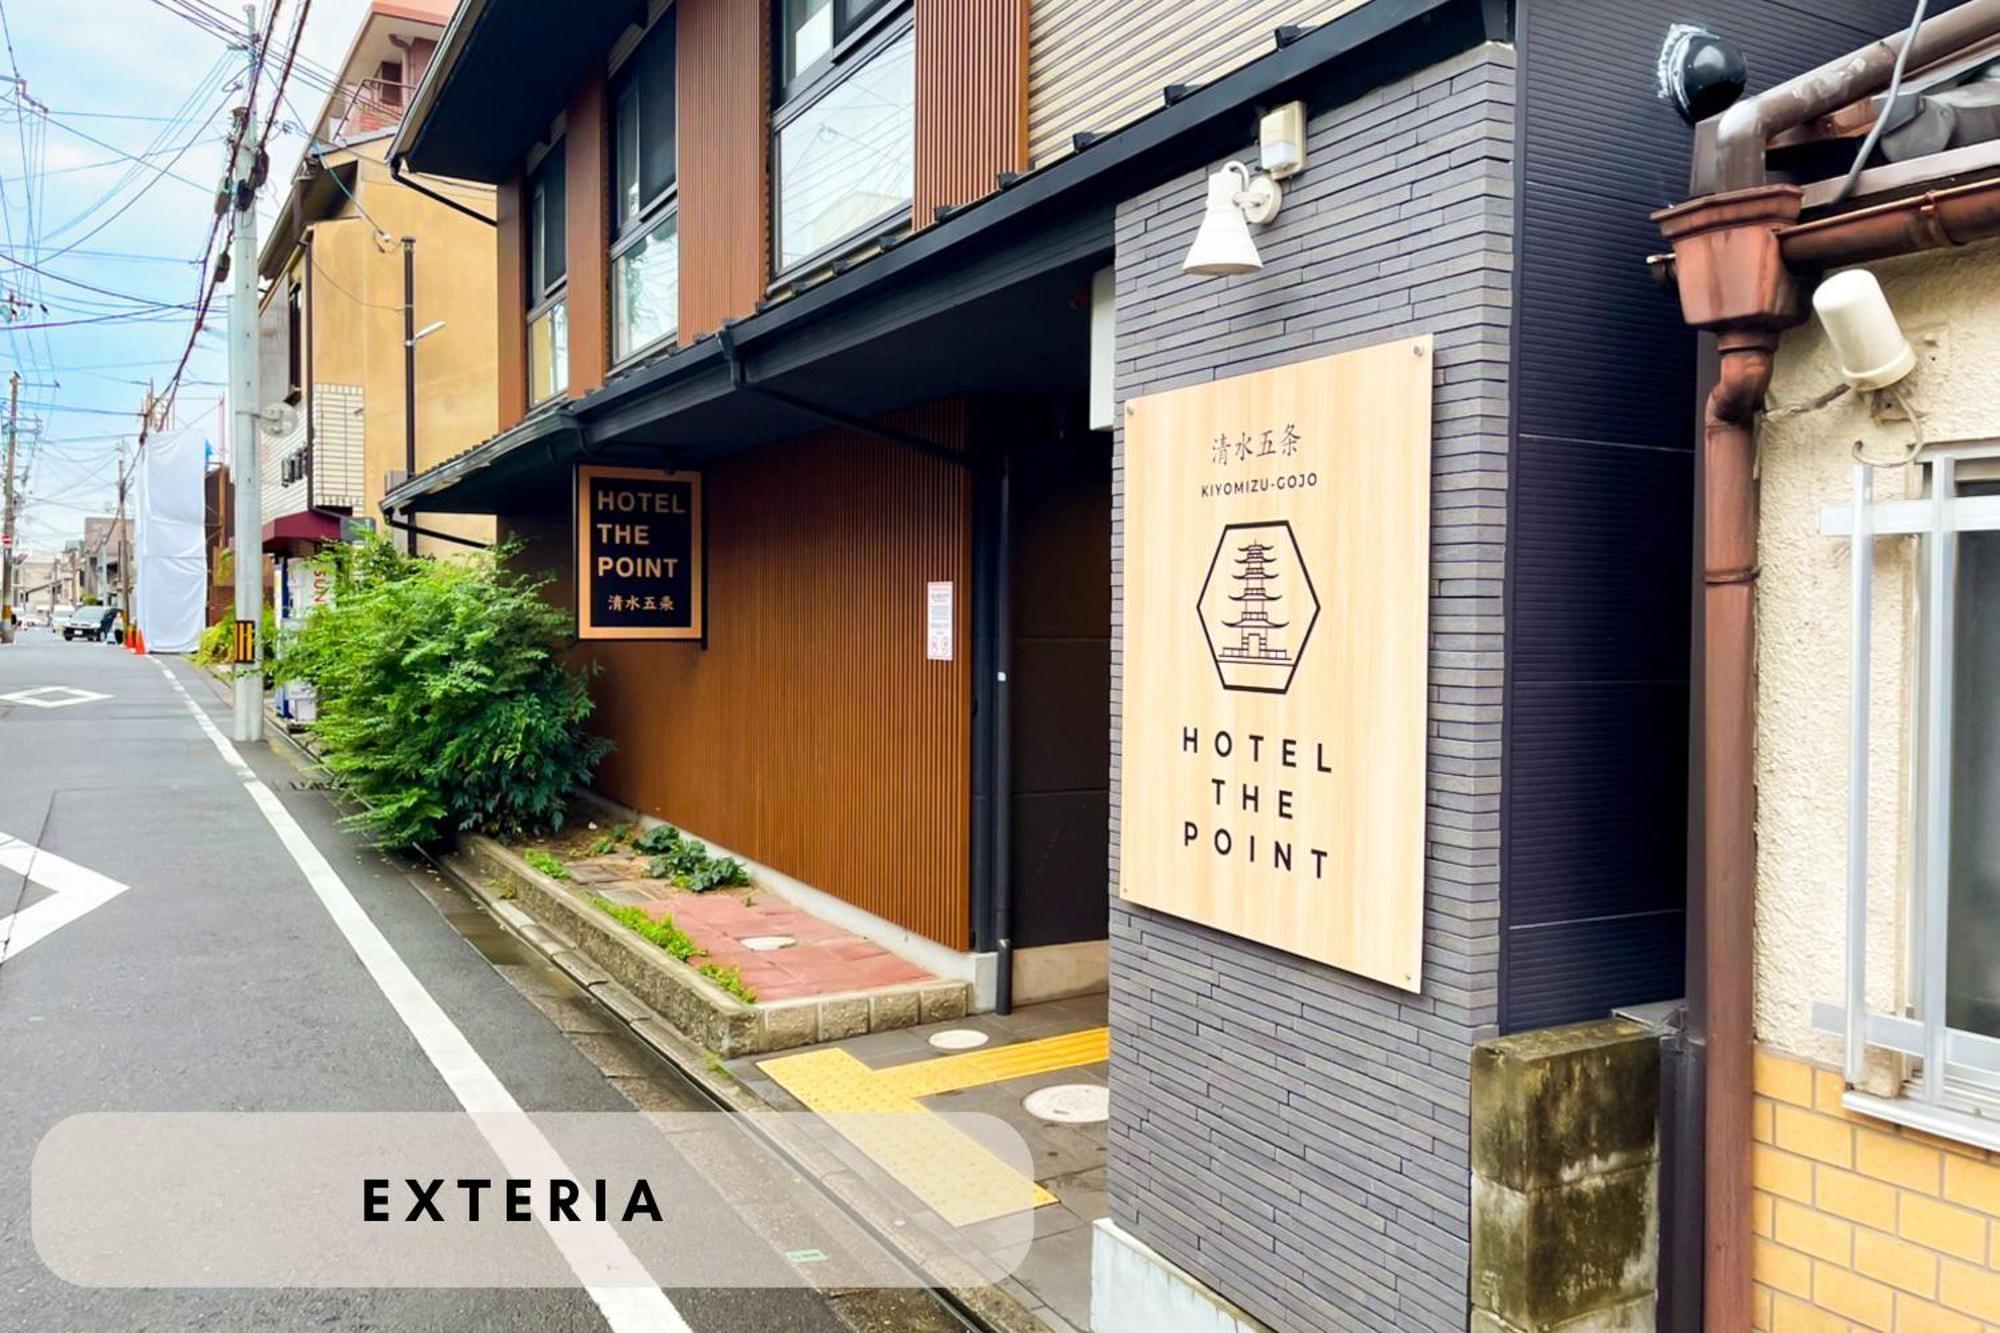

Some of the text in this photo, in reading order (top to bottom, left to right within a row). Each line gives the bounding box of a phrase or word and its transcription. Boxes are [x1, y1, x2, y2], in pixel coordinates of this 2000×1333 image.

[1212, 424, 1301, 465] 清水五条
[597, 490, 686, 514] HOTEL
[597, 523, 650, 545] THE
[598, 556, 678, 579] POINT
[608, 594, 675, 612] 清水五条
[1183, 726, 1332, 773] HOTEL
[1211, 778, 1293, 820] THE
[1184, 821, 1328, 879] POINT
